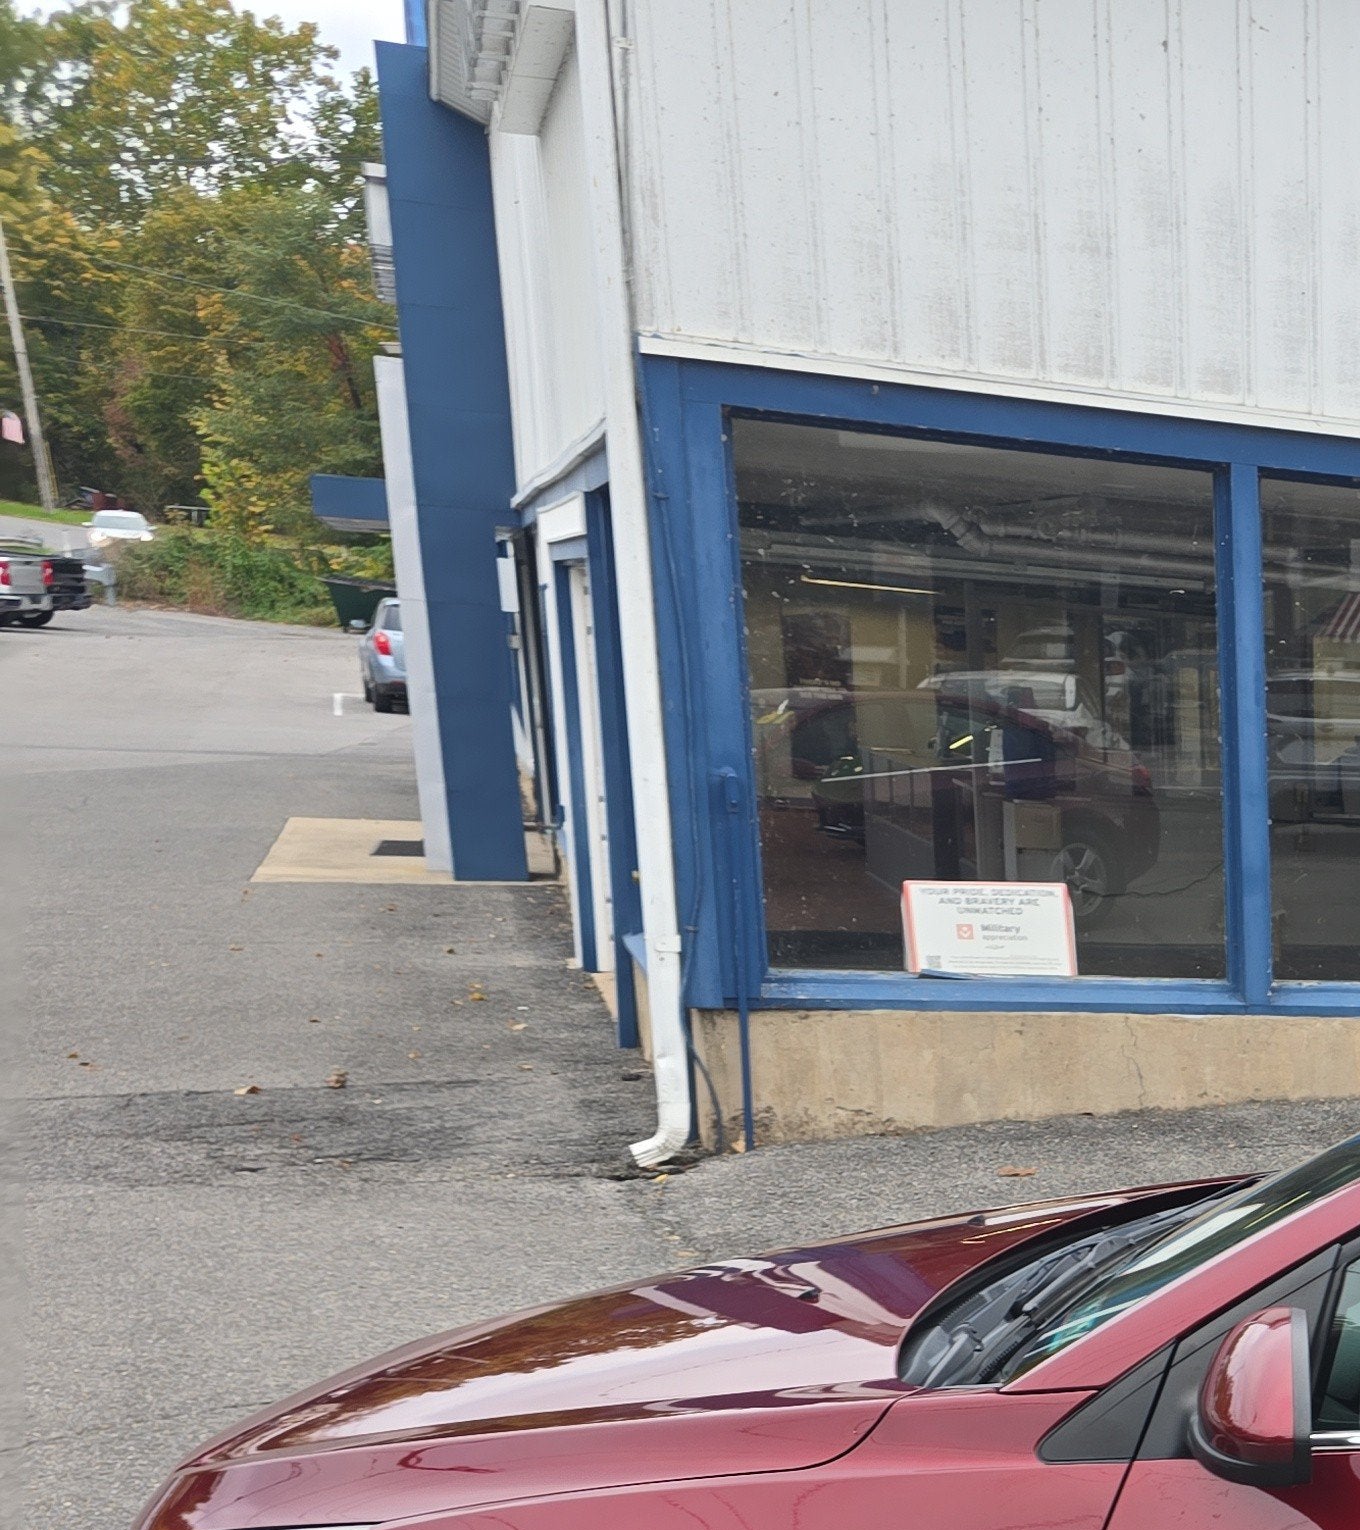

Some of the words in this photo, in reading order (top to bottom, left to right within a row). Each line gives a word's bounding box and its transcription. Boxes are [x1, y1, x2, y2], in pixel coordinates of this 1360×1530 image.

[939, 897, 961, 905] AND
[965, 898, 1014, 906] BRAVERY
[1018, 898, 1039, 906] ARE
[957, 907, 1023, 915] UNMATCHED
[981, 924, 1021, 933] Military
